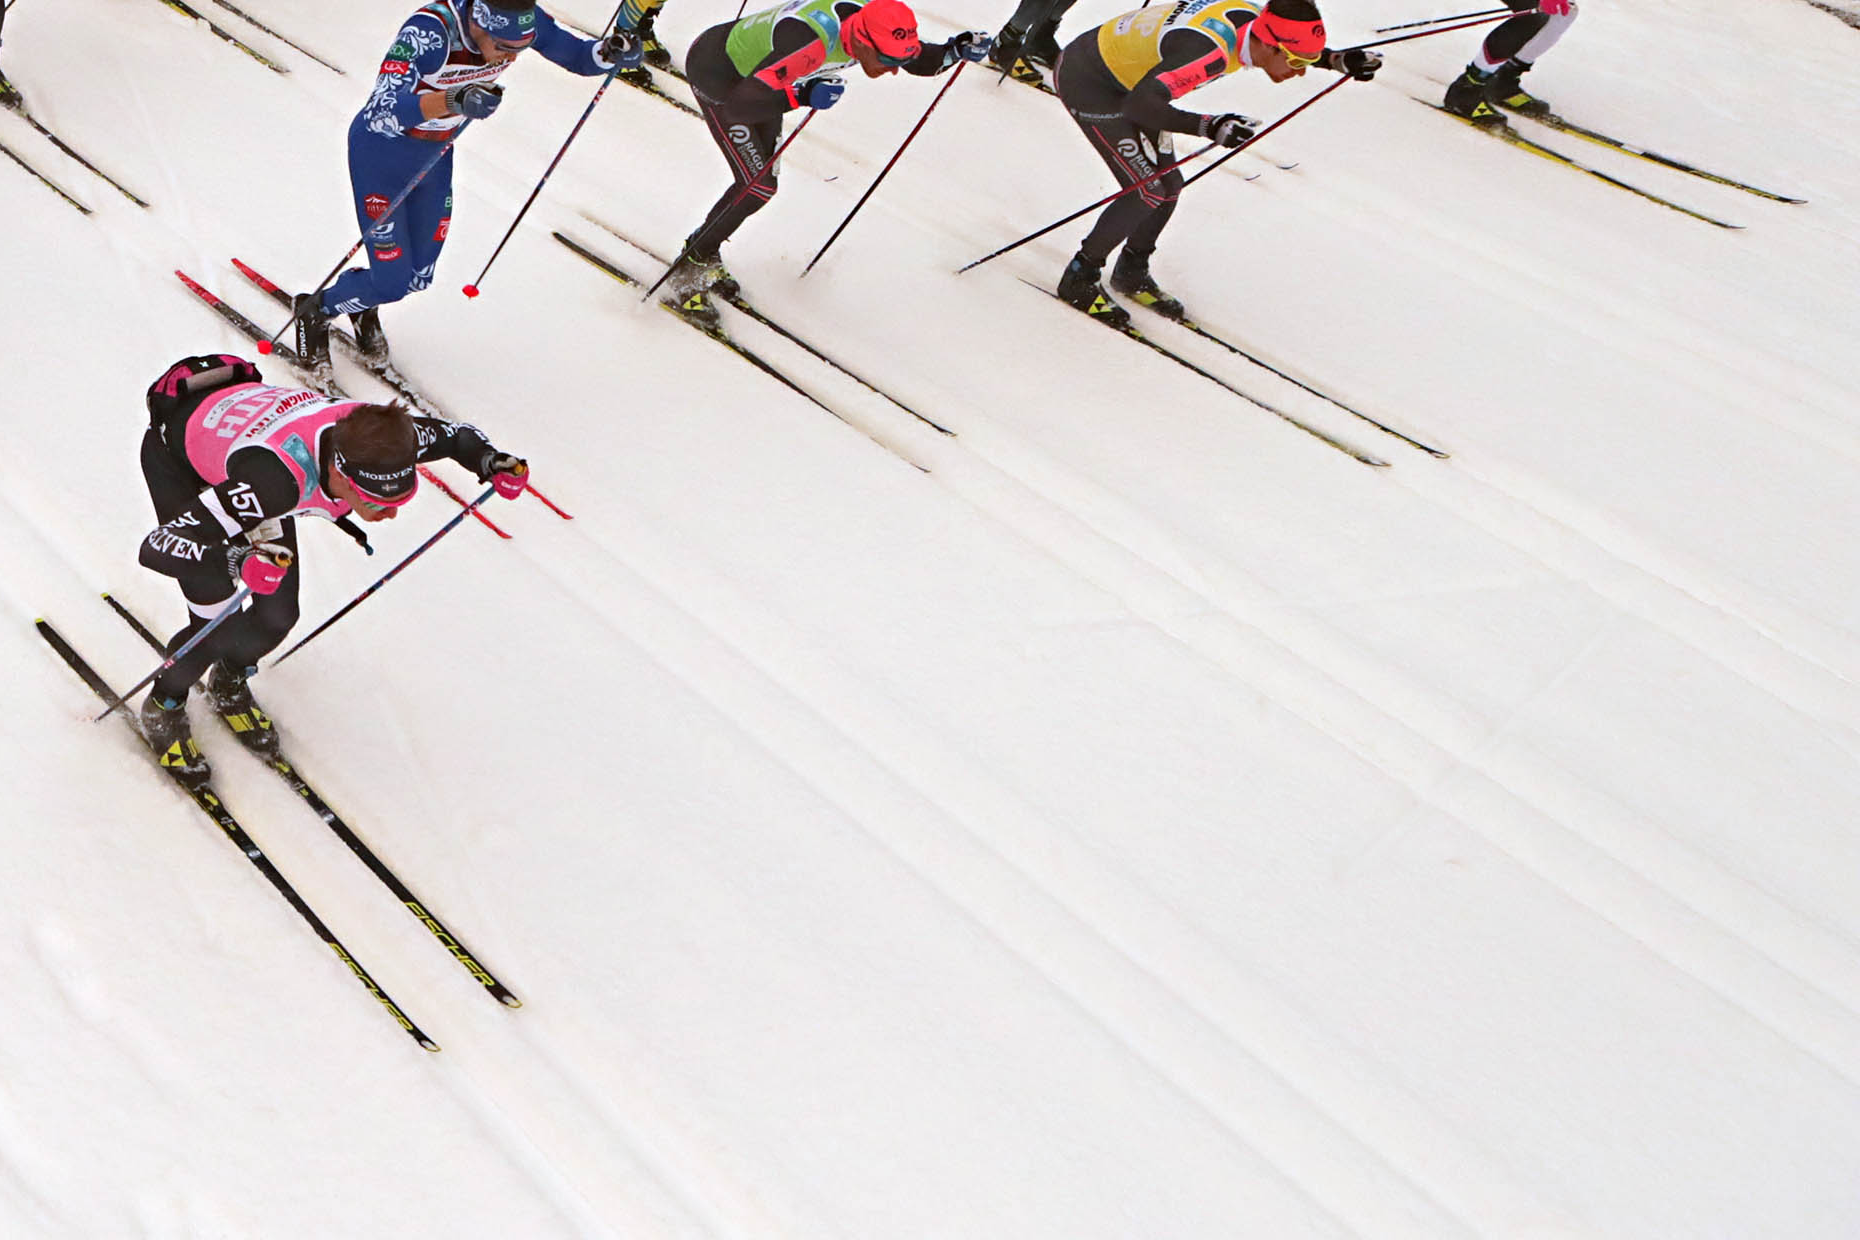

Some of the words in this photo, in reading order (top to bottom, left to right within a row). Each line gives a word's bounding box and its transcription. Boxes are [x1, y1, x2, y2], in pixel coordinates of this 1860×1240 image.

[745, 141, 764, 171] RAGD
[298, 320, 308, 358] ATOMIC
[358, 465, 414, 481] MOELVEN
[227, 481, 265, 519] 157
[404, 901, 496, 988] FISCHER
[328, 941, 415, 1031] FISCHER
